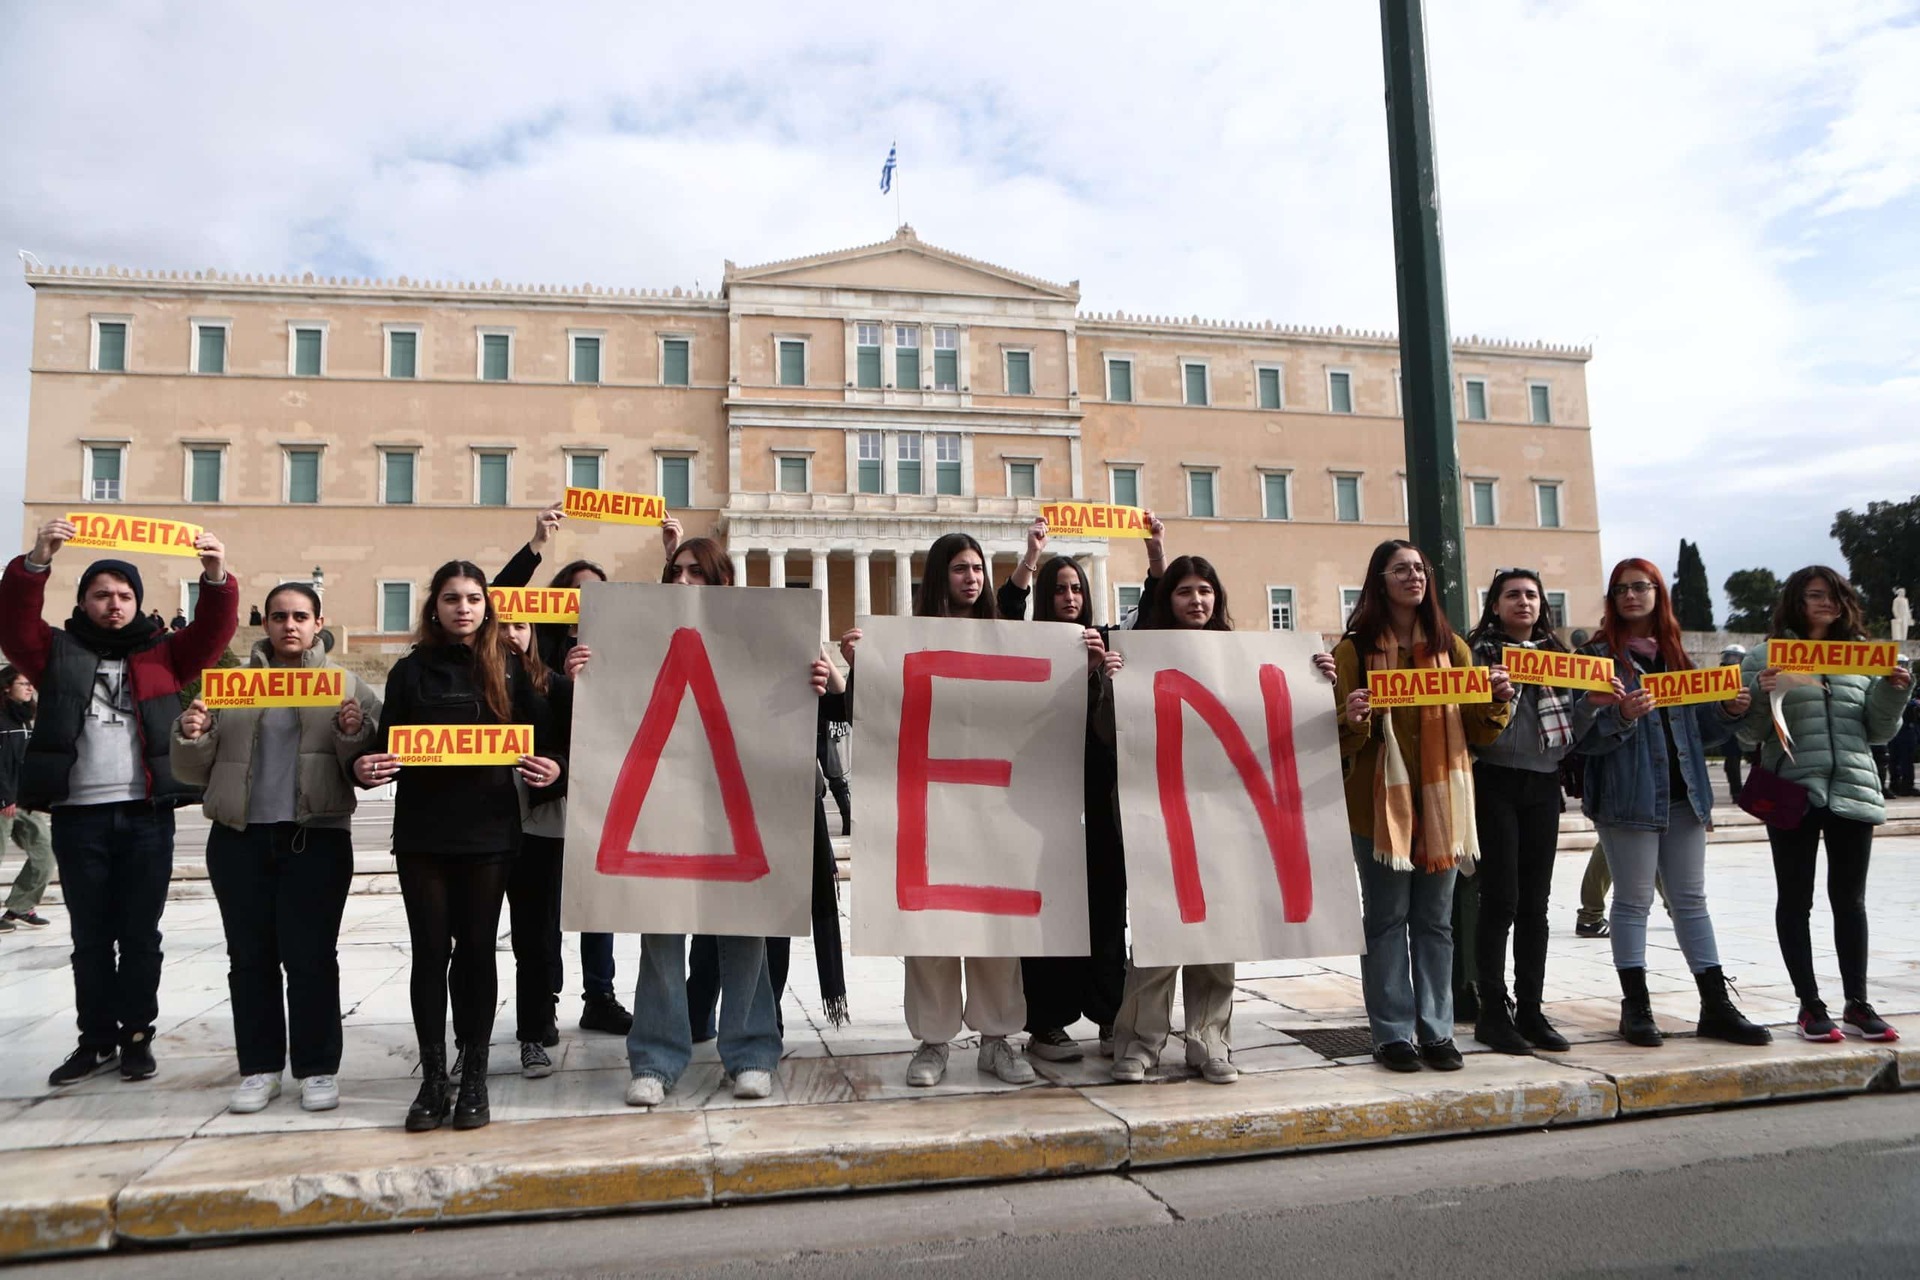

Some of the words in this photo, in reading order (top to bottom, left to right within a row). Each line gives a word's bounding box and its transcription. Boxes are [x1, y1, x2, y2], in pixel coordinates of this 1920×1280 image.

[566, 490, 663, 518] ΠΩΛΕΙΤΑΙ
[489, 590, 579, 614] ΩΛΕΙΤΑ
[1506, 651, 1611, 682] ΠΩΛΕΙΤΑΙ
[1771, 643, 1895, 667] ΠΩΛΕΙΤΑΙ
[205, 672, 341, 697] ΠΩΛΕΙΤΑΙ
[1371, 670, 1489, 697] ΠΩΛΕΙΤΑΙ
[1644, 669, 1740, 698] ΠΩΛΕΙΤΑΙ
[205, 698, 255, 706] ΠΛΗΡΟΦΟΡΙΕΣ
[393, 729, 529, 754] ΠΩΛΕΙΤΑΙ
[597, 628, 769, 881] Δ
[897, 650, 1050, 916] Ε
[1154, 664, 1312, 923] Ν
